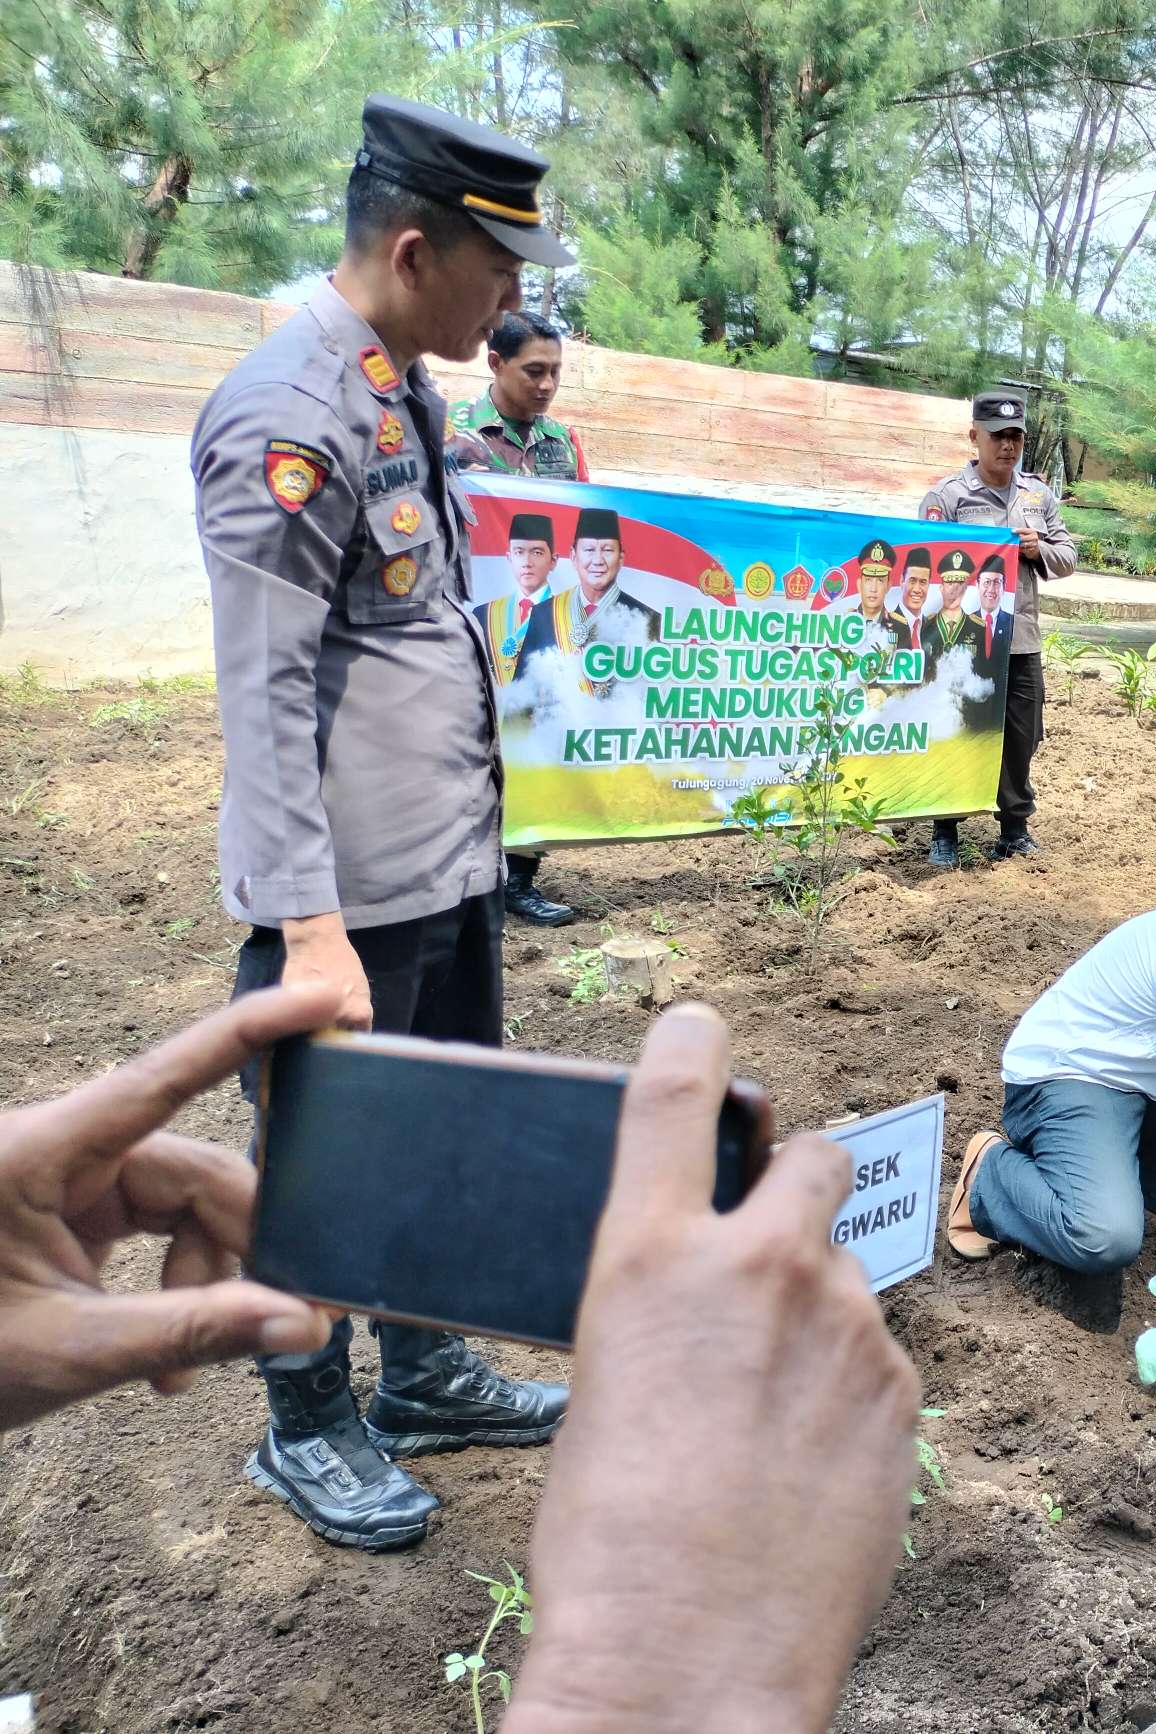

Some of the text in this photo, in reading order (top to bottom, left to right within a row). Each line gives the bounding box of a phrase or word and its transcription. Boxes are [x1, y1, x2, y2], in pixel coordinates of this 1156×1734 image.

[663, 607, 864, 644] LAUNCHING
[584, 645, 719, 680] GUGUS
[725, 648, 836, 681] TUGAS
[645, 687, 865, 719] MENDUKUNG
[563, 727, 794, 762] KETAHANAN
[751, 776, 763, 785] 20
[855, 1151, 902, 1192] SEK
[833, 1191, 917, 1245] GWARU
